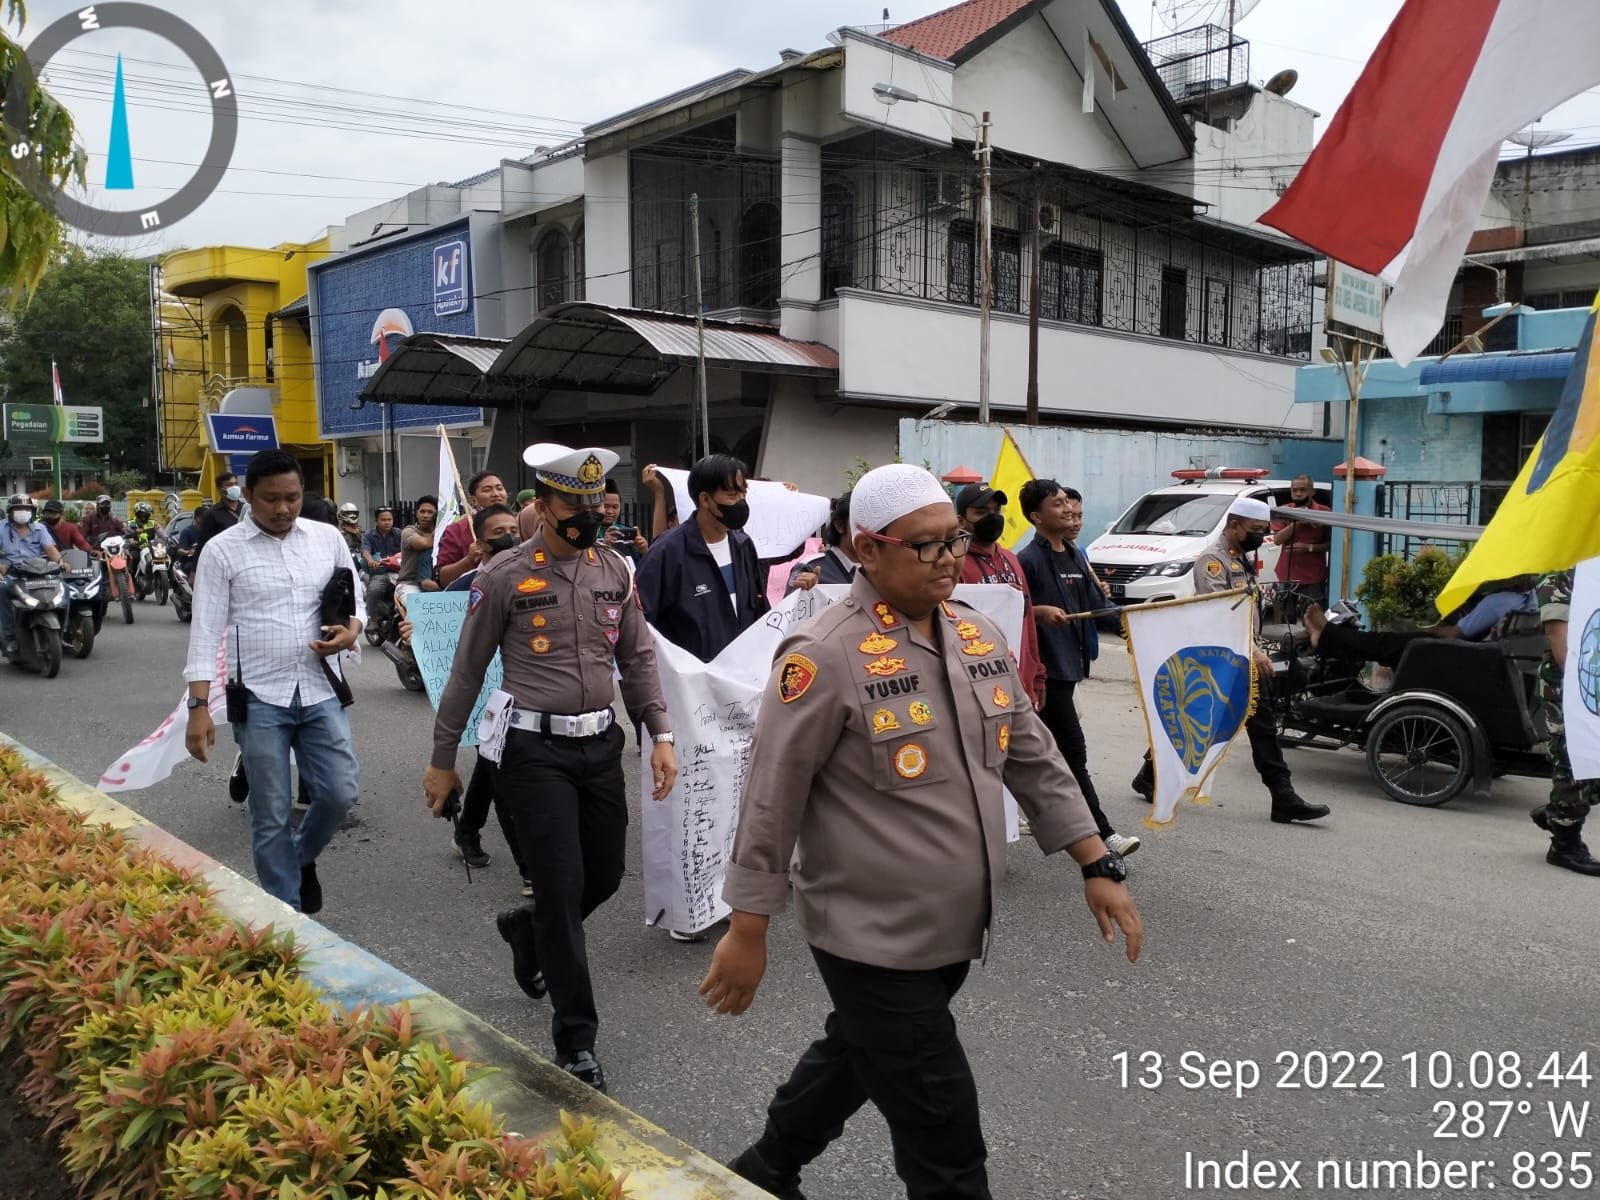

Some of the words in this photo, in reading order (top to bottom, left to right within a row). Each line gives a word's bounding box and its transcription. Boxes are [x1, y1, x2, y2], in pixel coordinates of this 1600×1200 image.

[437, 249, 461, 287] kf
[11, 421, 48, 429] Pegadaian
[420, 618, 458, 636] YANG
[968, 659, 1010, 679] POLRI
[864, 675, 919, 700] YUSUF
